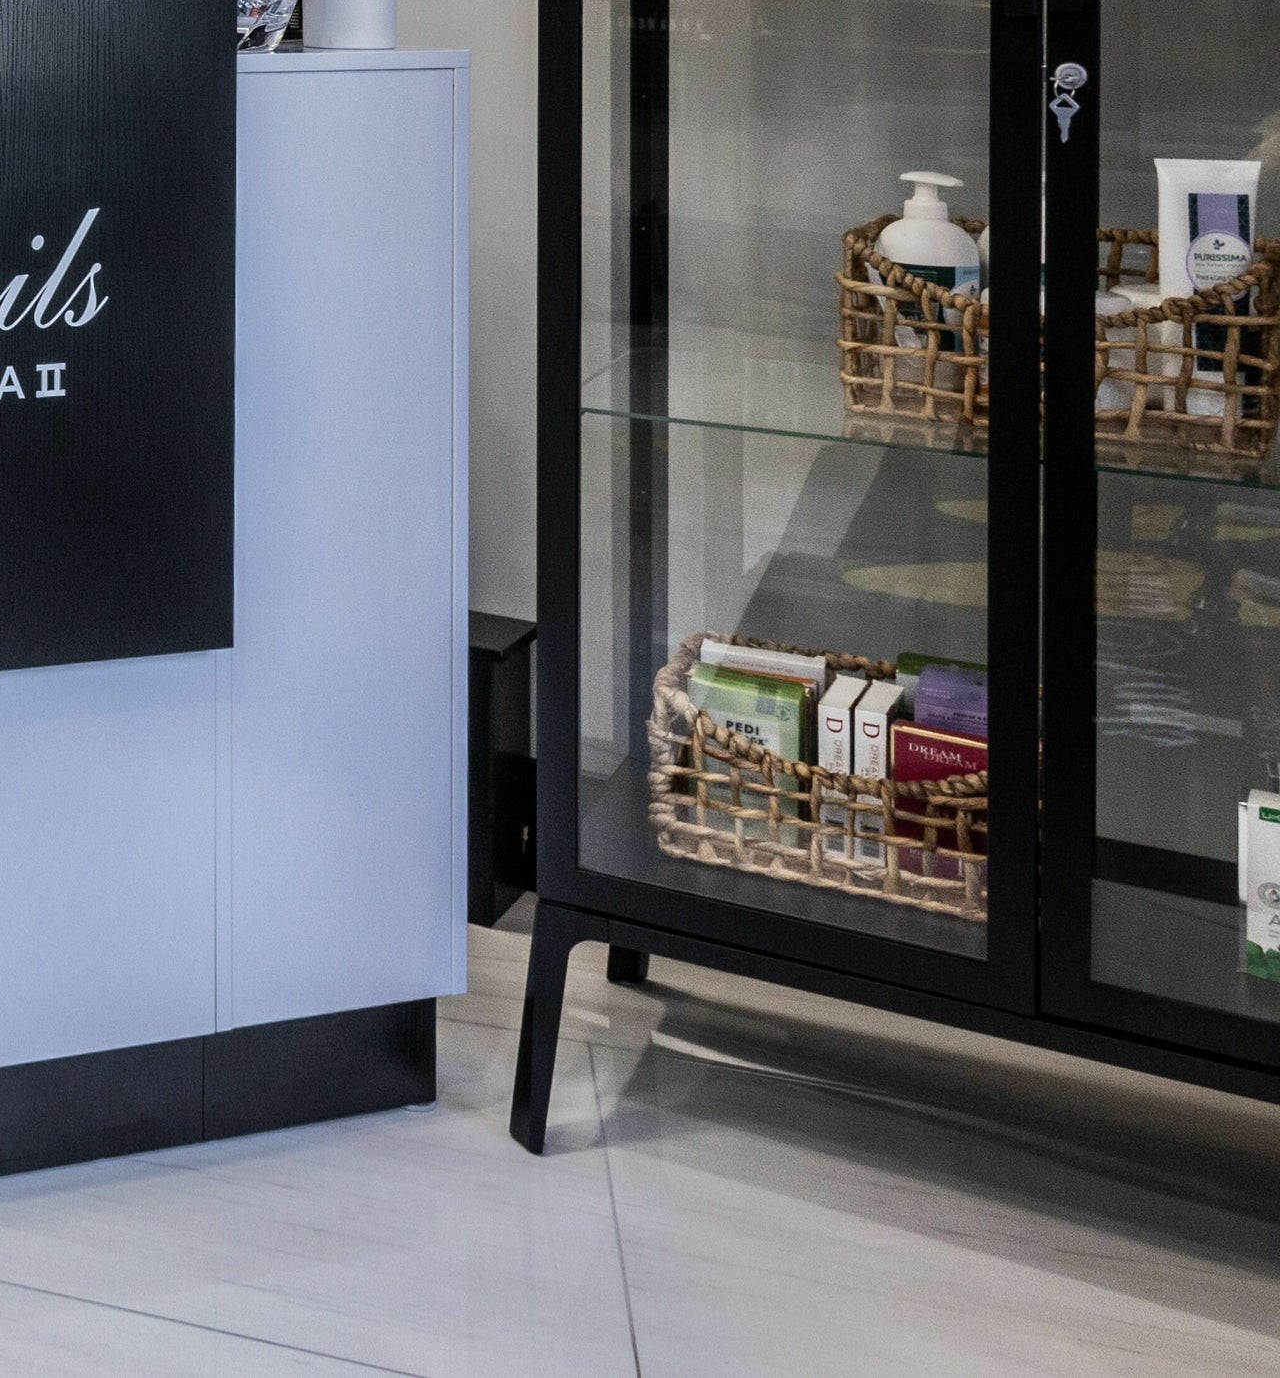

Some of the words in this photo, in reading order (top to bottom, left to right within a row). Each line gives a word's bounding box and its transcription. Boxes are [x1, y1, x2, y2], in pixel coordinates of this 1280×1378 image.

[1194, 253, 1247, 262] PURISSIMA
[35, 362, 67, 399] II
[726, 720, 759, 735] PEDI
[827, 717, 843, 733] D
[863, 722, 880, 739] D
[908, 742, 961, 761] DREAM
